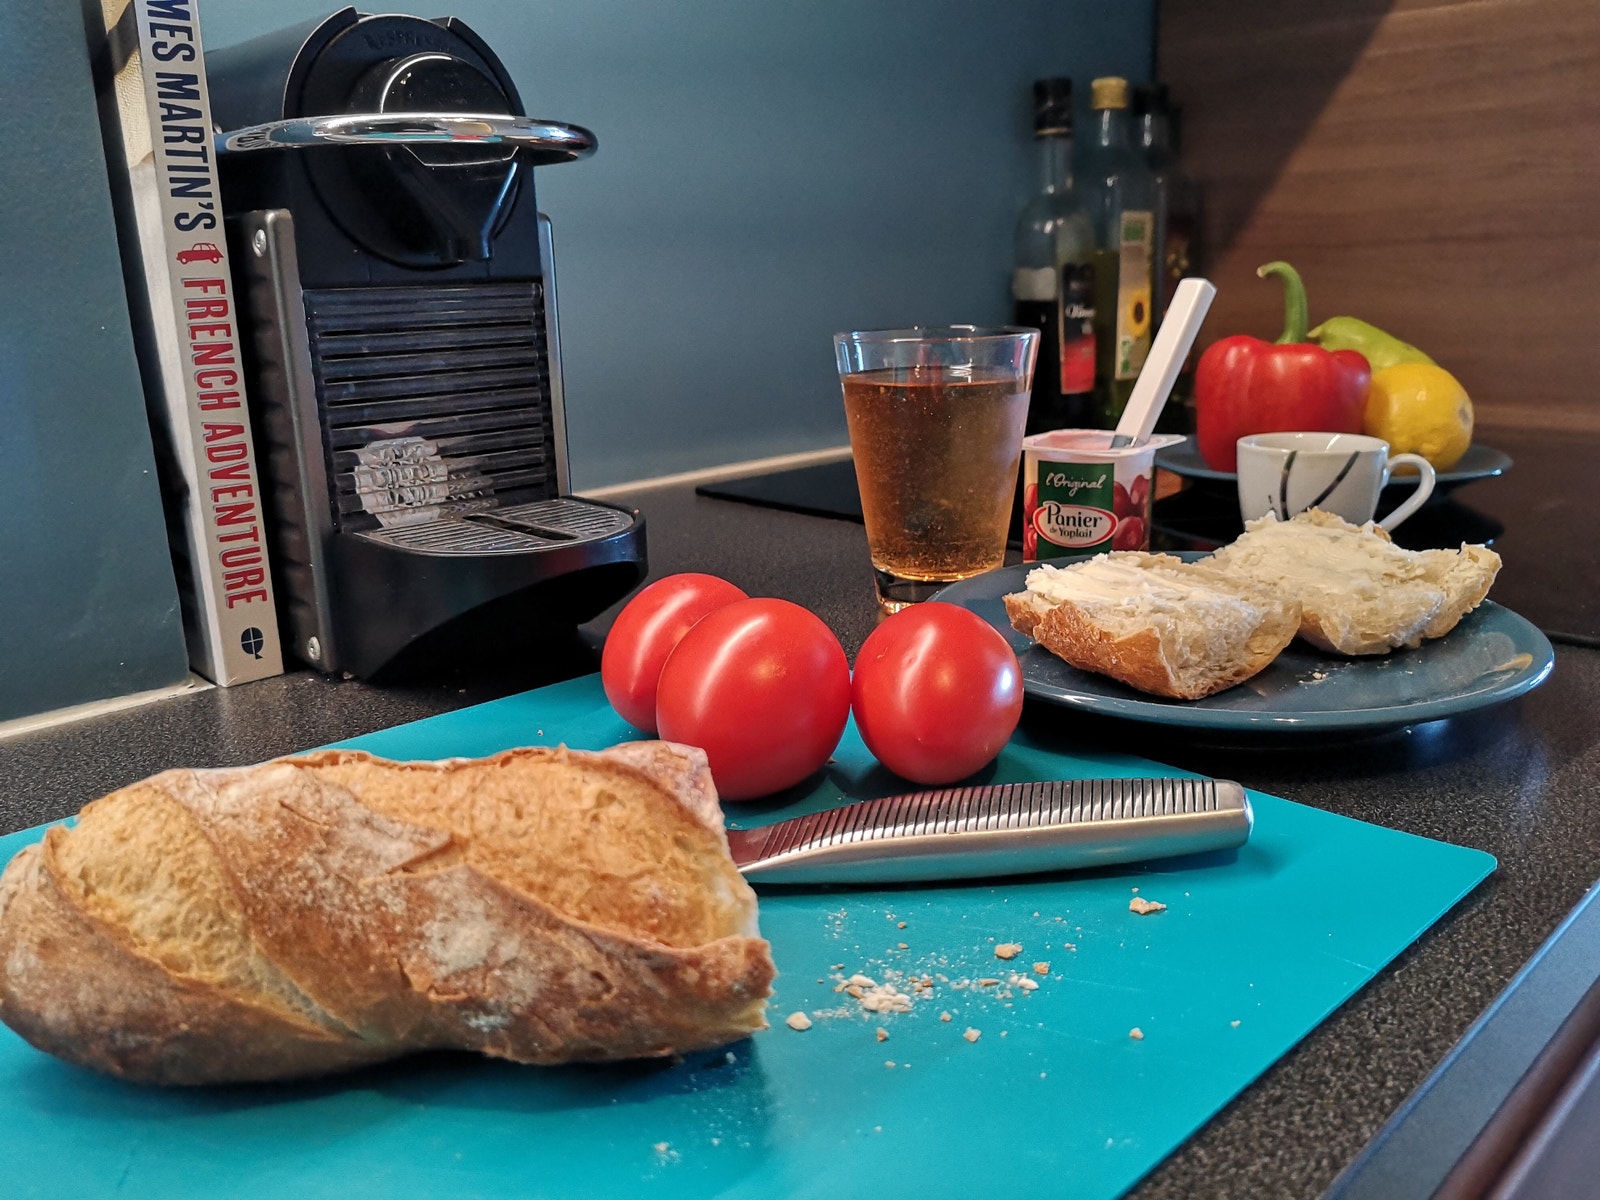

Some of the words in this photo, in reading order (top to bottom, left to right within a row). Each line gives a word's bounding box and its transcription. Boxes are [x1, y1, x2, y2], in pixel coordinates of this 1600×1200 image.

[146, 0, 196, 62] MES
[155, 72, 217, 232] MARTIN'S
[182, 278, 241, 411] FRENCH
[202, 422, 268, 609] ADVENTURE
[1047, 503, 1102, 528] Panier
[1059, 527, 1092, 539] Yoplait
